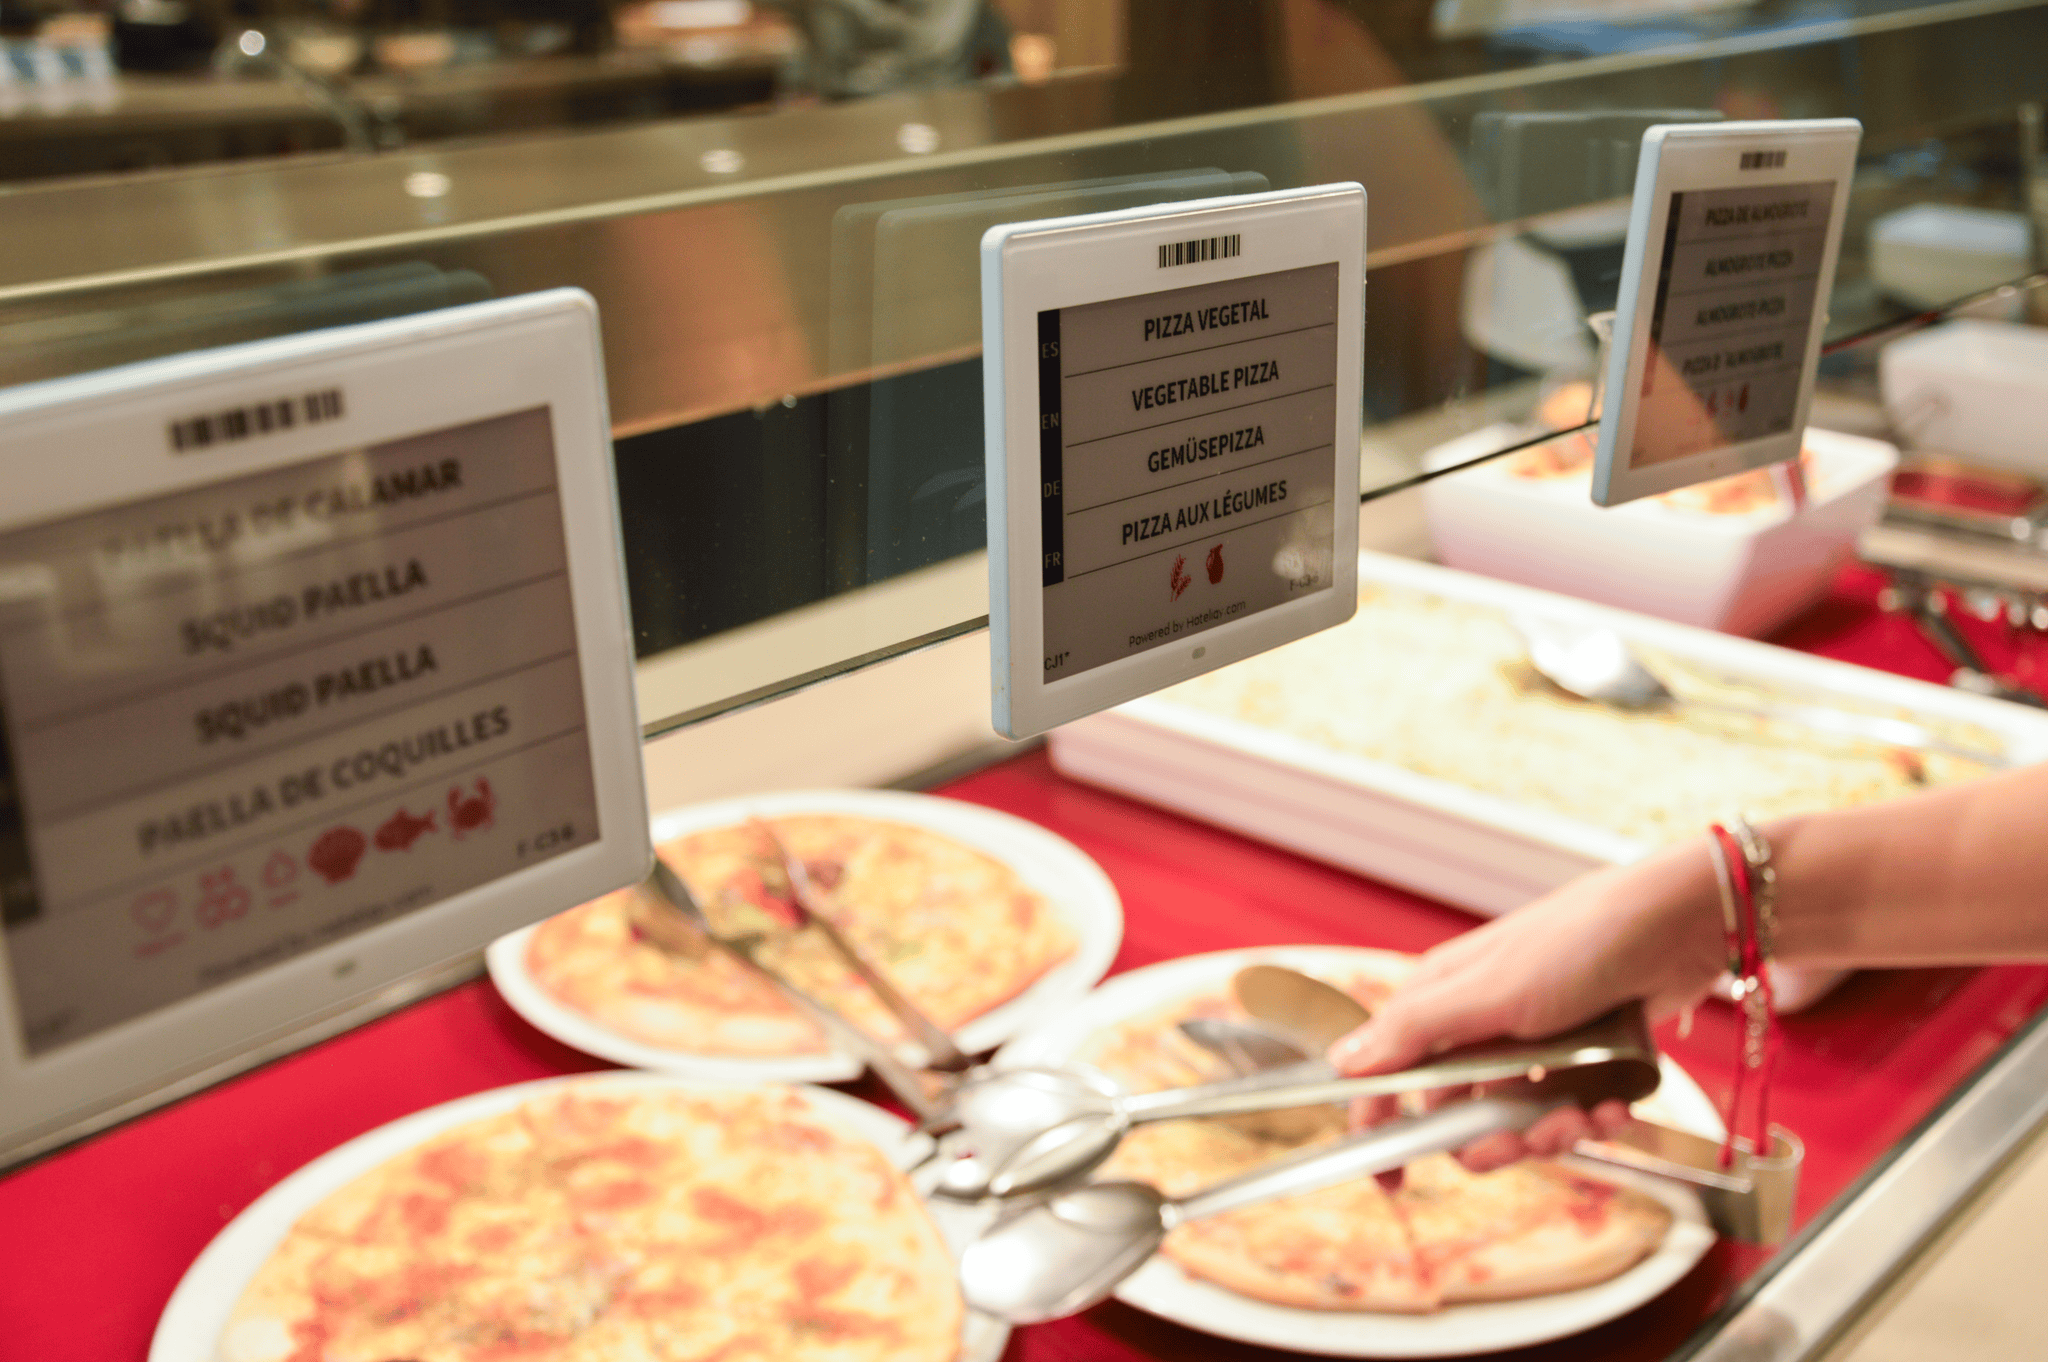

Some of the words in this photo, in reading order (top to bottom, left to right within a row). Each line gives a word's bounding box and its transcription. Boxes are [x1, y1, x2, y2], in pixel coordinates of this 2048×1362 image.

[1144, 312, 1194, 342] PIZZA
[1198, 298, 1269, 332] VEGETAL
[1042, 341, 1059, 359] ES
[1132, 370, 1230, 412] VEGETABLE
[1234, 360, 1280, 390] PIZZA
[1041, 412, 1059, 430] EN
[1147, 425, 1265, 473] GEMÜSEPIZZA
[1044, 479, 1061, 498] DE
[1122, 512, 1172, 545] PIZZA
[1176, 500, 1210, 531] AUX
[1214, 479, 1288, 520] LÉGUMES
[1045, 551, 1062, 569] FR
[180, 594, 300, 655] SQUID
[302, 556, 429, 622] PAELLA
[1129, 622, 1171, 648] Powered
[1173, 620, 1185, 634] by
[194, 681, 312, 746] SQUID
[313, 643, 438, 706] PAELLA
[137, 784, 274, 856] PAELLA
[279, 766, 327, 810] DE
[331, 704, 513, 790] COQUILLES
